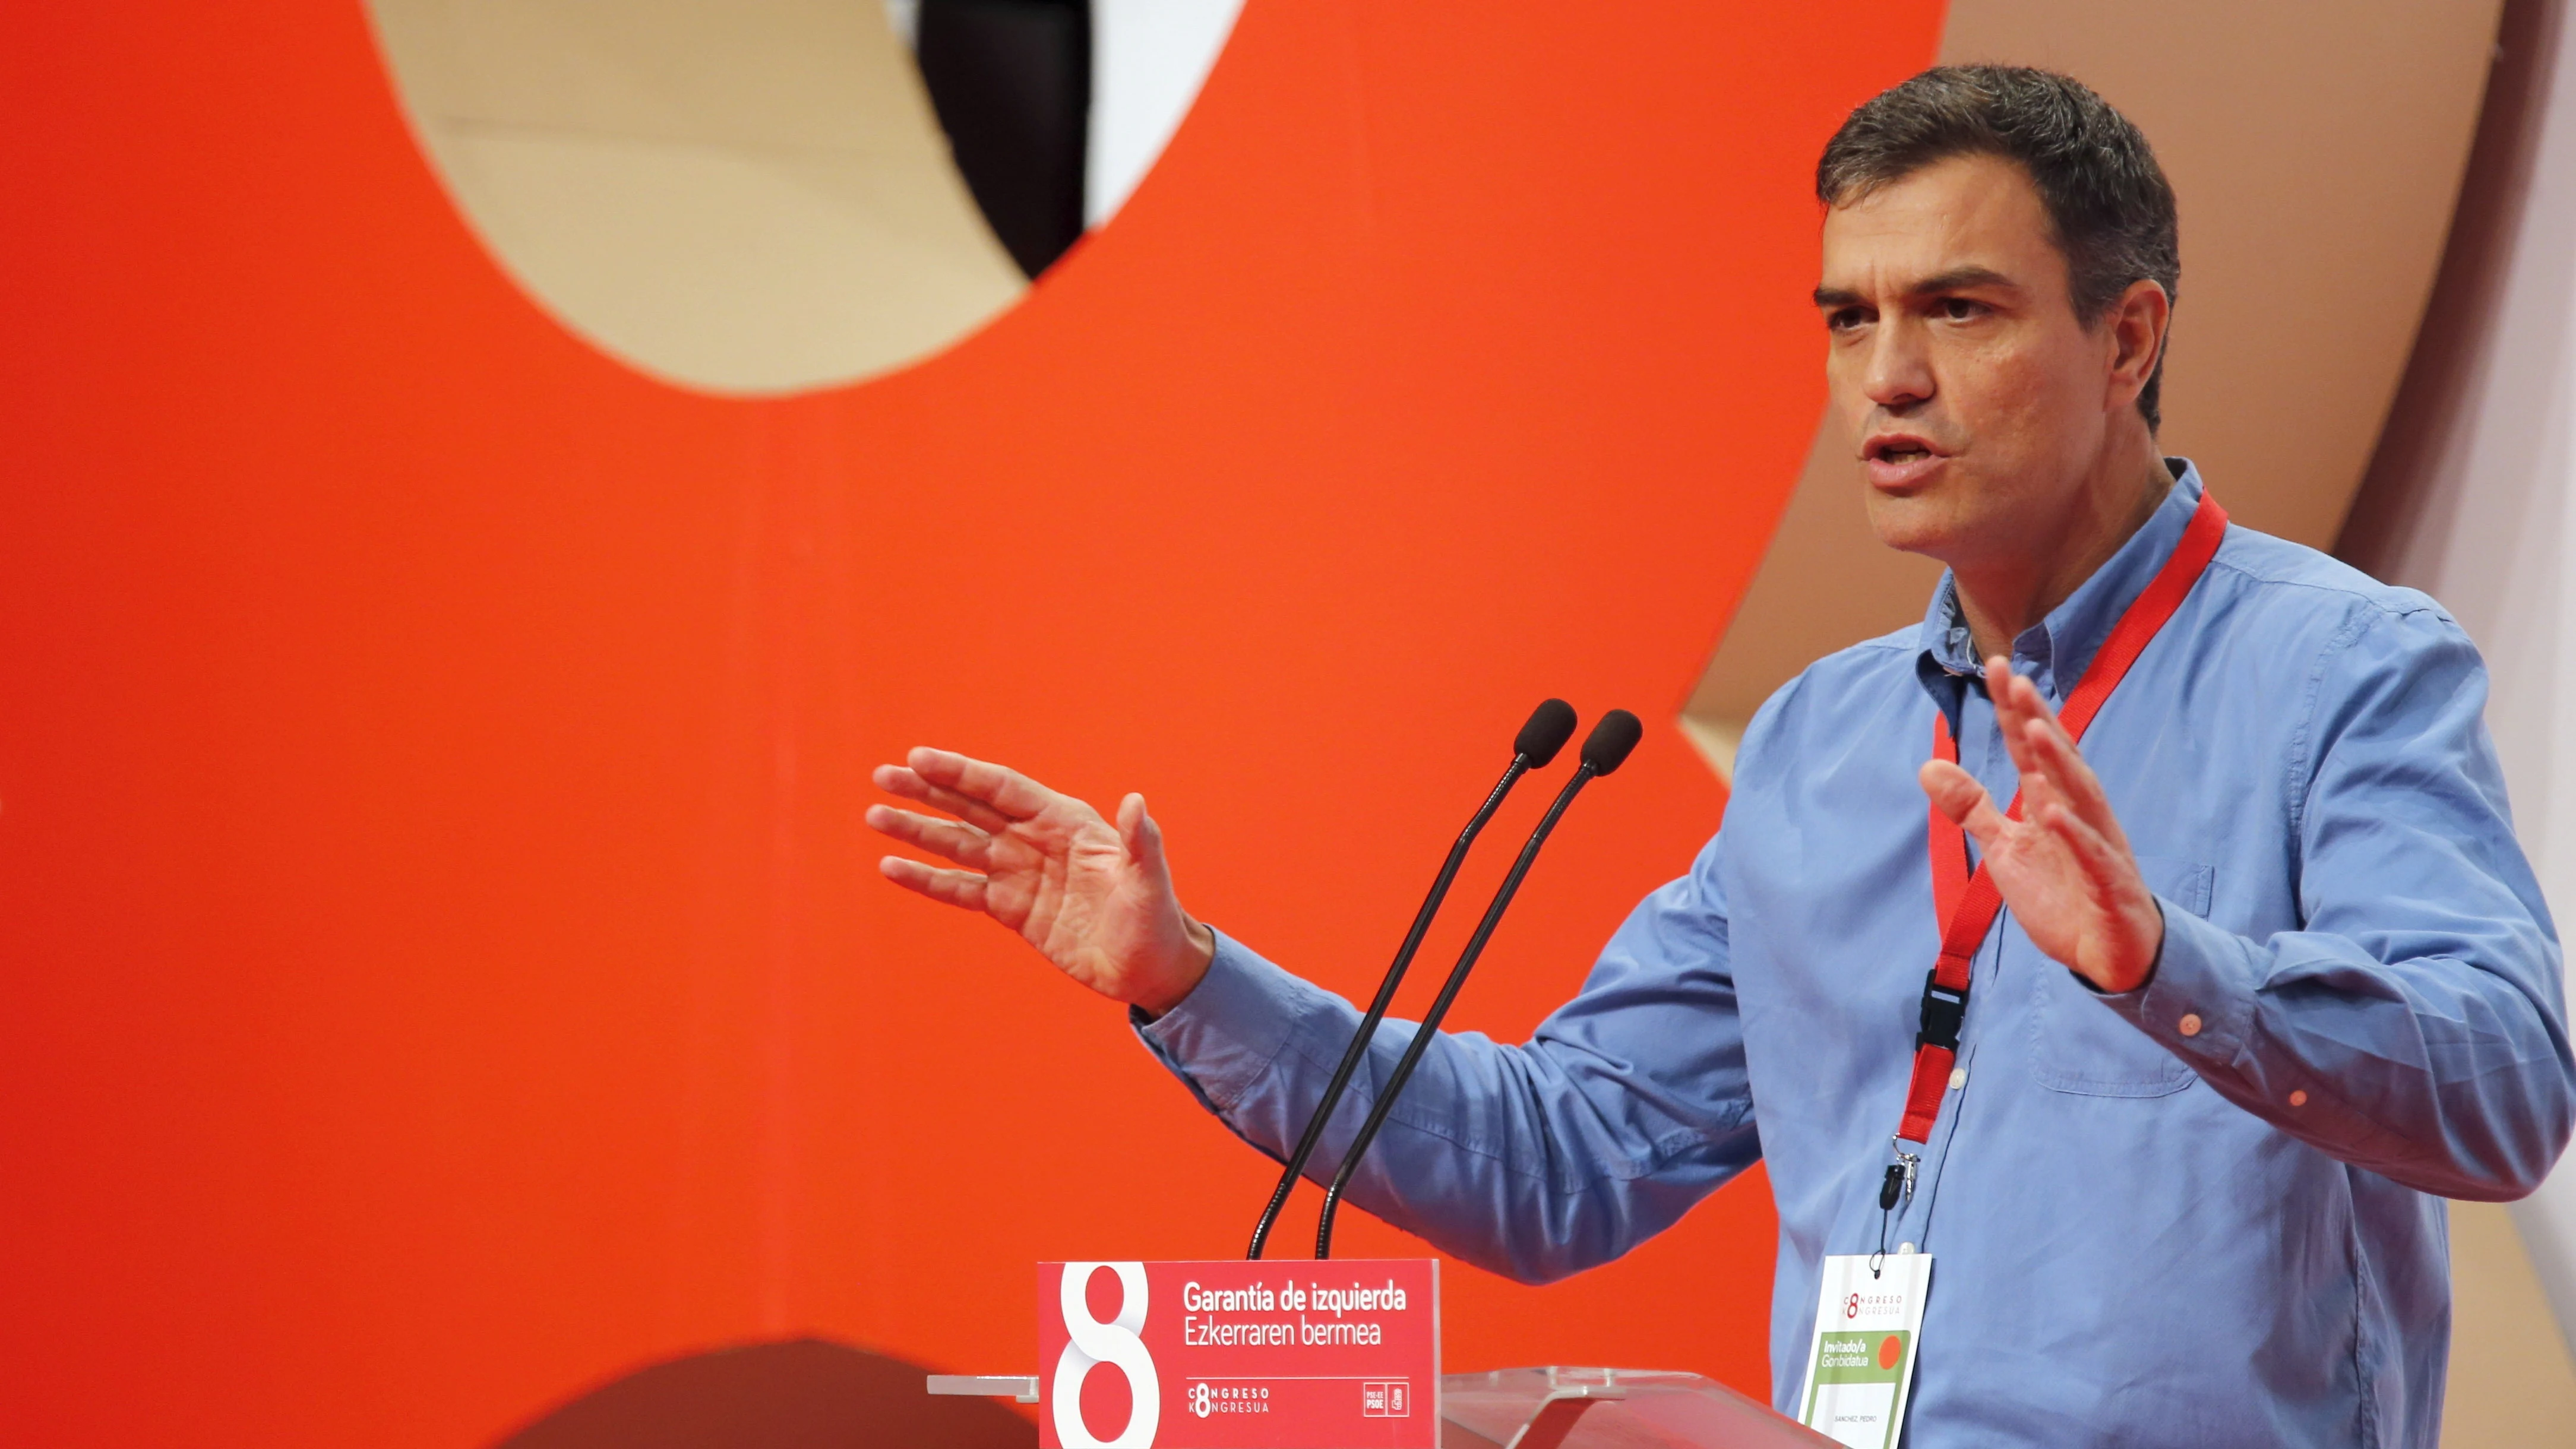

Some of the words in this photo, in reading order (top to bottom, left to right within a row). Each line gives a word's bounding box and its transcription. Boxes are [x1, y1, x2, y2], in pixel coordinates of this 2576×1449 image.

[1184, 1281, 1274, 1312] Garantía
[1280, 1280, 1306, 1311] de
[1312, 1279, 1406, 1318] izquierda
[1185, 1315, 1294, 1346] Ezkerraren
[1301, 1314, 1381, 1345] bermea
[1824, 1339, 1866, 1353] Invitado/a
[1822, 1353, 1869, 1367] Gonbidatua
[1367, 1399, 1384, 1409] PSOE
